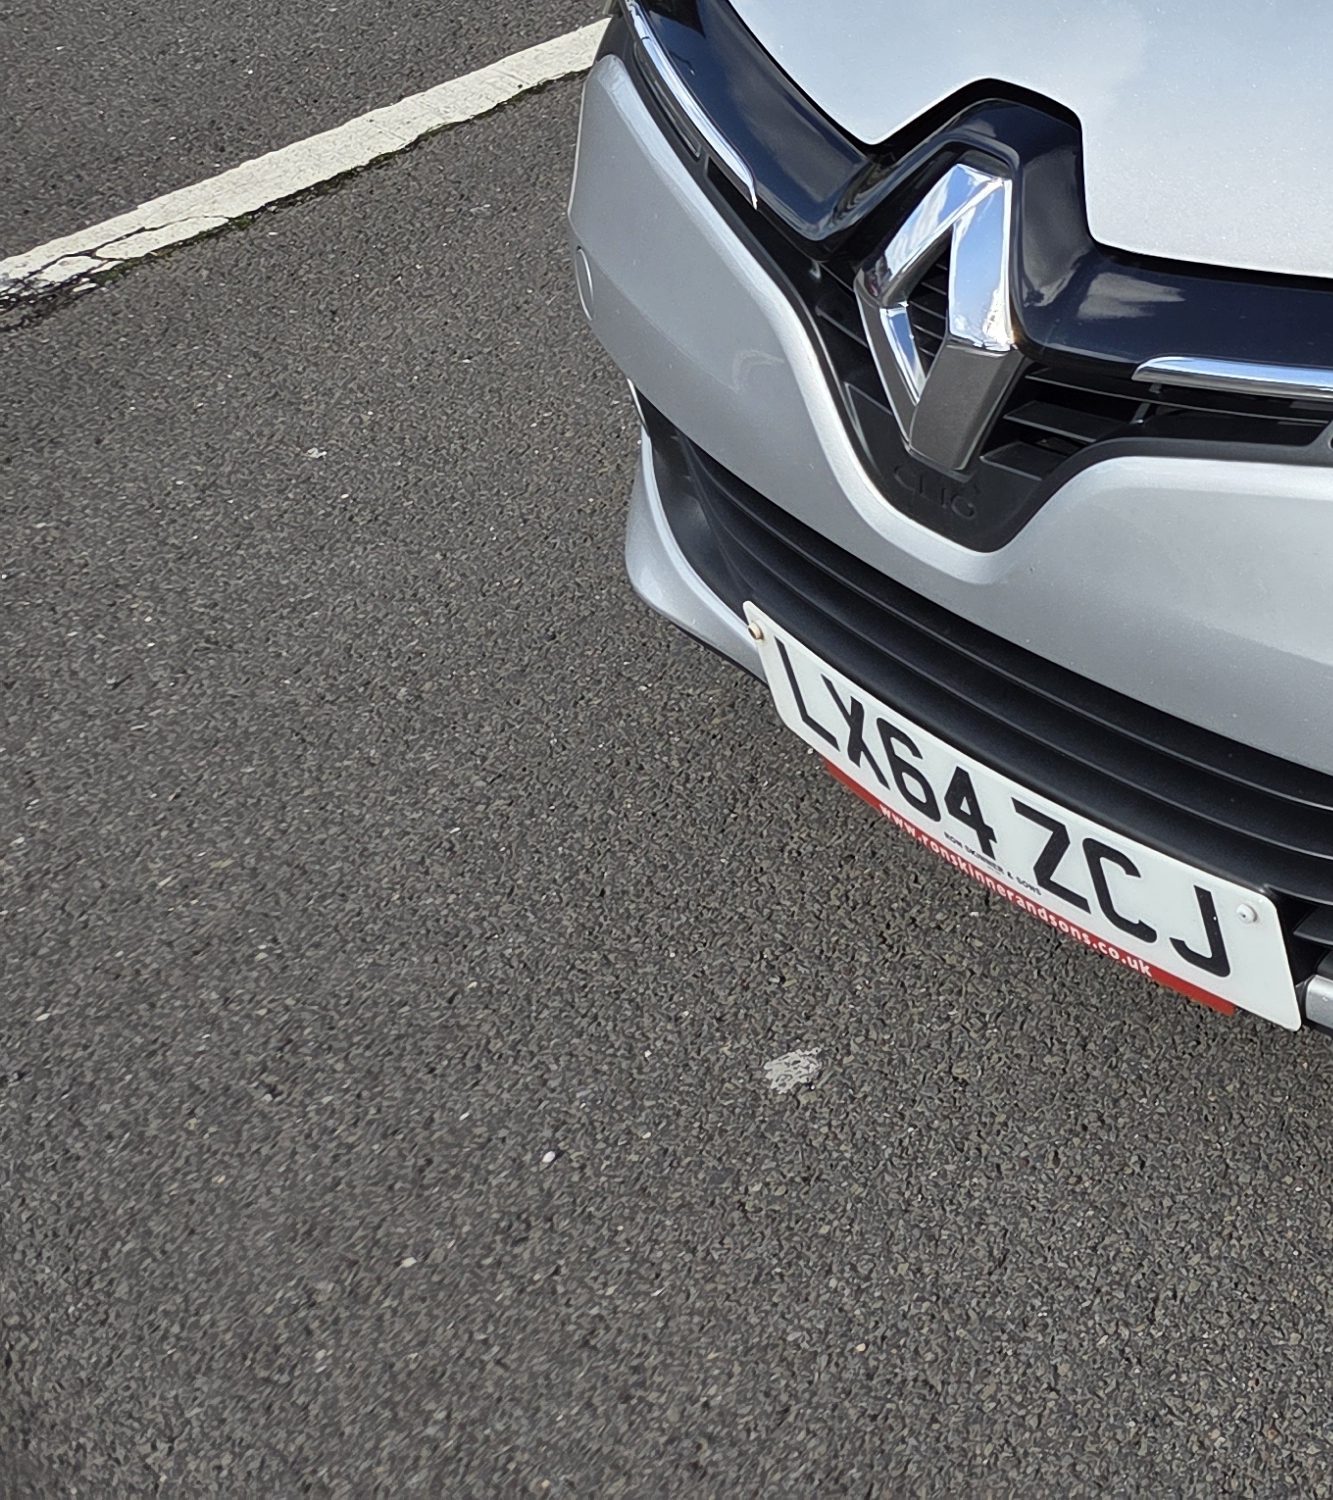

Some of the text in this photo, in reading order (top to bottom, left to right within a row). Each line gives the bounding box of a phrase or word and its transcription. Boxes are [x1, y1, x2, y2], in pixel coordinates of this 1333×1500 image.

[774, 636, 1232, 978] LX64 ZCJ
[878, 802, 1153, 978] www.ronskinnerandsons.co.uk
